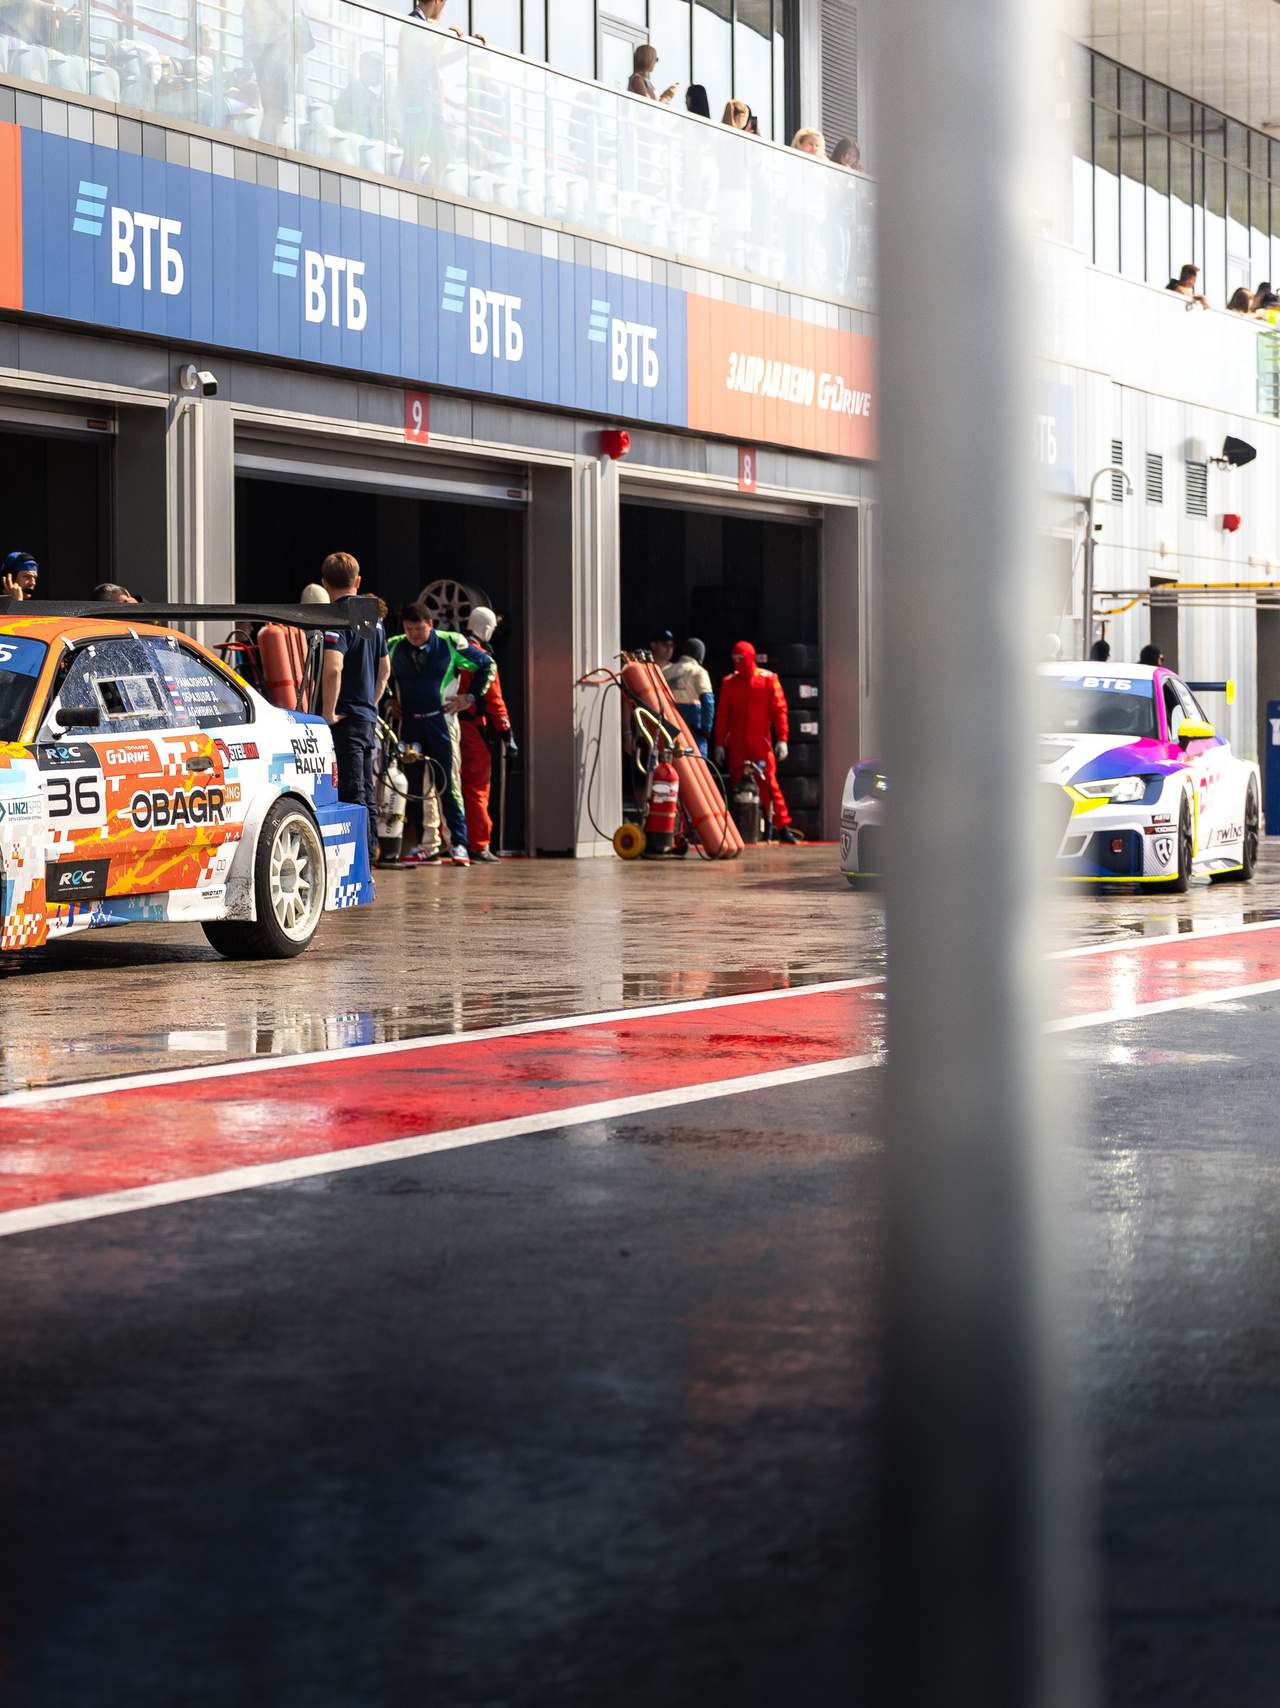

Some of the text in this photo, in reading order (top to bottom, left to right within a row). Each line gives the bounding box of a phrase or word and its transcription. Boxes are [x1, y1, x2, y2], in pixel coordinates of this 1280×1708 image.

[111, 206, 185, 296] ВТБ
[304, 249, 368, 331] ВТБ
[468, 286, 523, 362] ВТБ
[611, 317, 660, 388] ВТБ
[725, 351, 816, 407] ЗАПРАВЛЕНО
[411, 399, 423, 432] 9
[1037, 414, 1058, 465] ТБ
[742, 453, 752, 485] 8
[1082, 676, 1132, 691] ВТБ
[228, 742, 259, 761] STELKON
[290, 738, 319, 755] RUST
[295, 757, 325, 775] RALLY
[47, 775, 100, 818] 36
